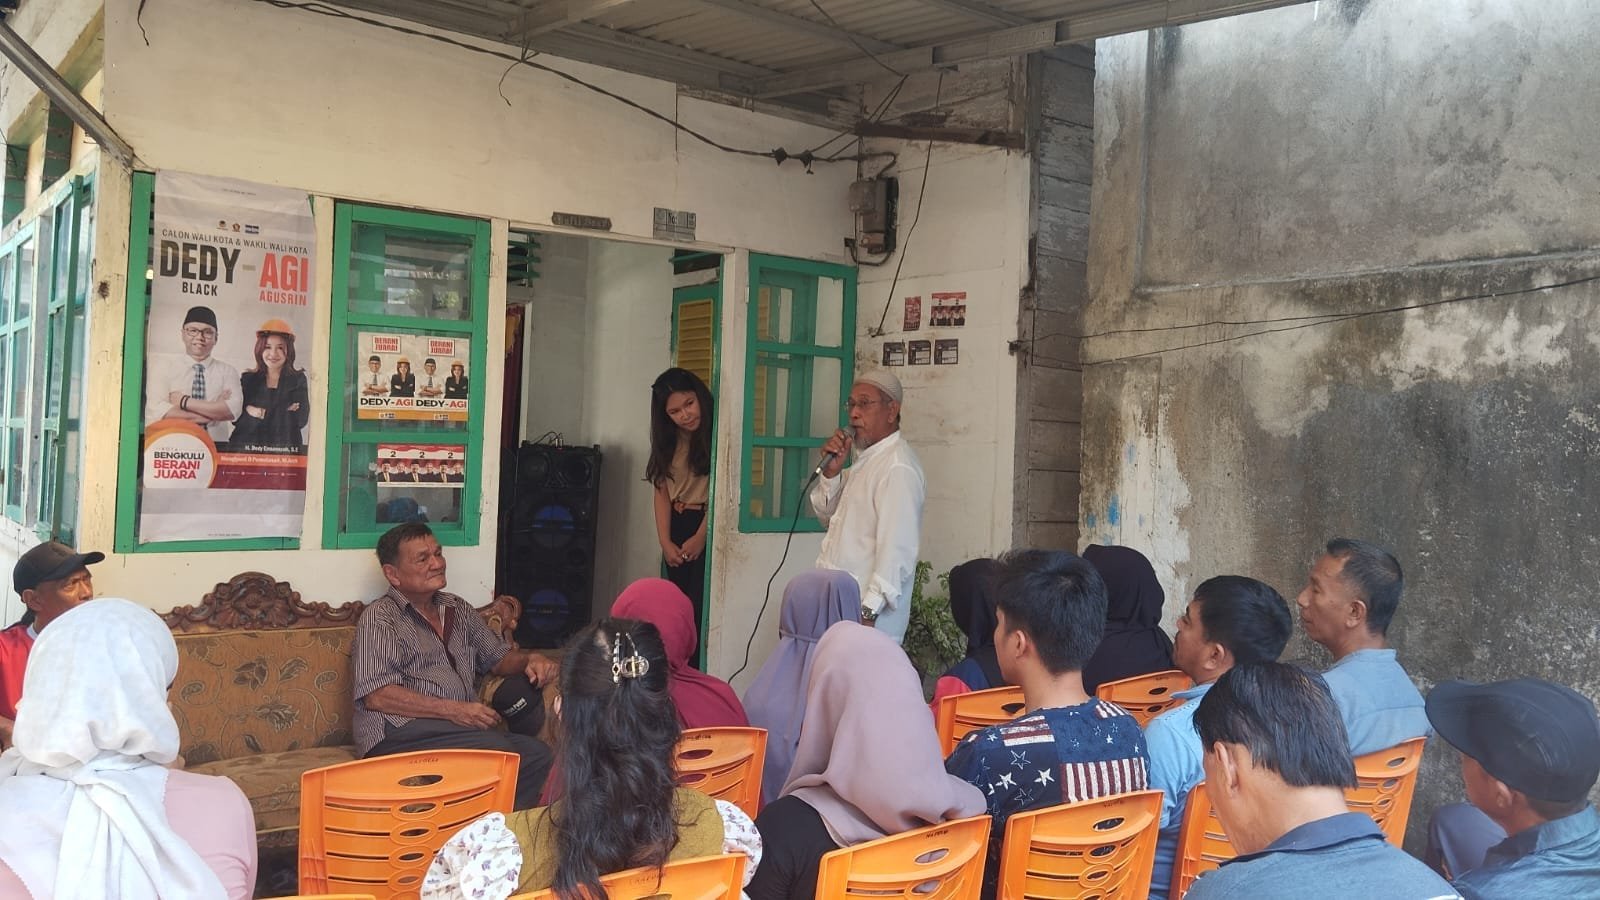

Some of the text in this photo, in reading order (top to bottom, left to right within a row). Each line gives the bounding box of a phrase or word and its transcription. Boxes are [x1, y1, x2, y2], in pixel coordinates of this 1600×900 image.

[162, 228, 308, 255] CALON WALI KOTA & WAKIL WALI KOTA
[159, 239, 241, 284] DEDY
[259, 253, 309, 293] AGI
[182, 281, 218, 297] BLACK
[259, 290, 307, 306] AGUSRIN
[153, 451, 205, 460] BENGKULU
[153, 459, 201, 470] BERANI
[153, 469, 197, 480] JUARA
